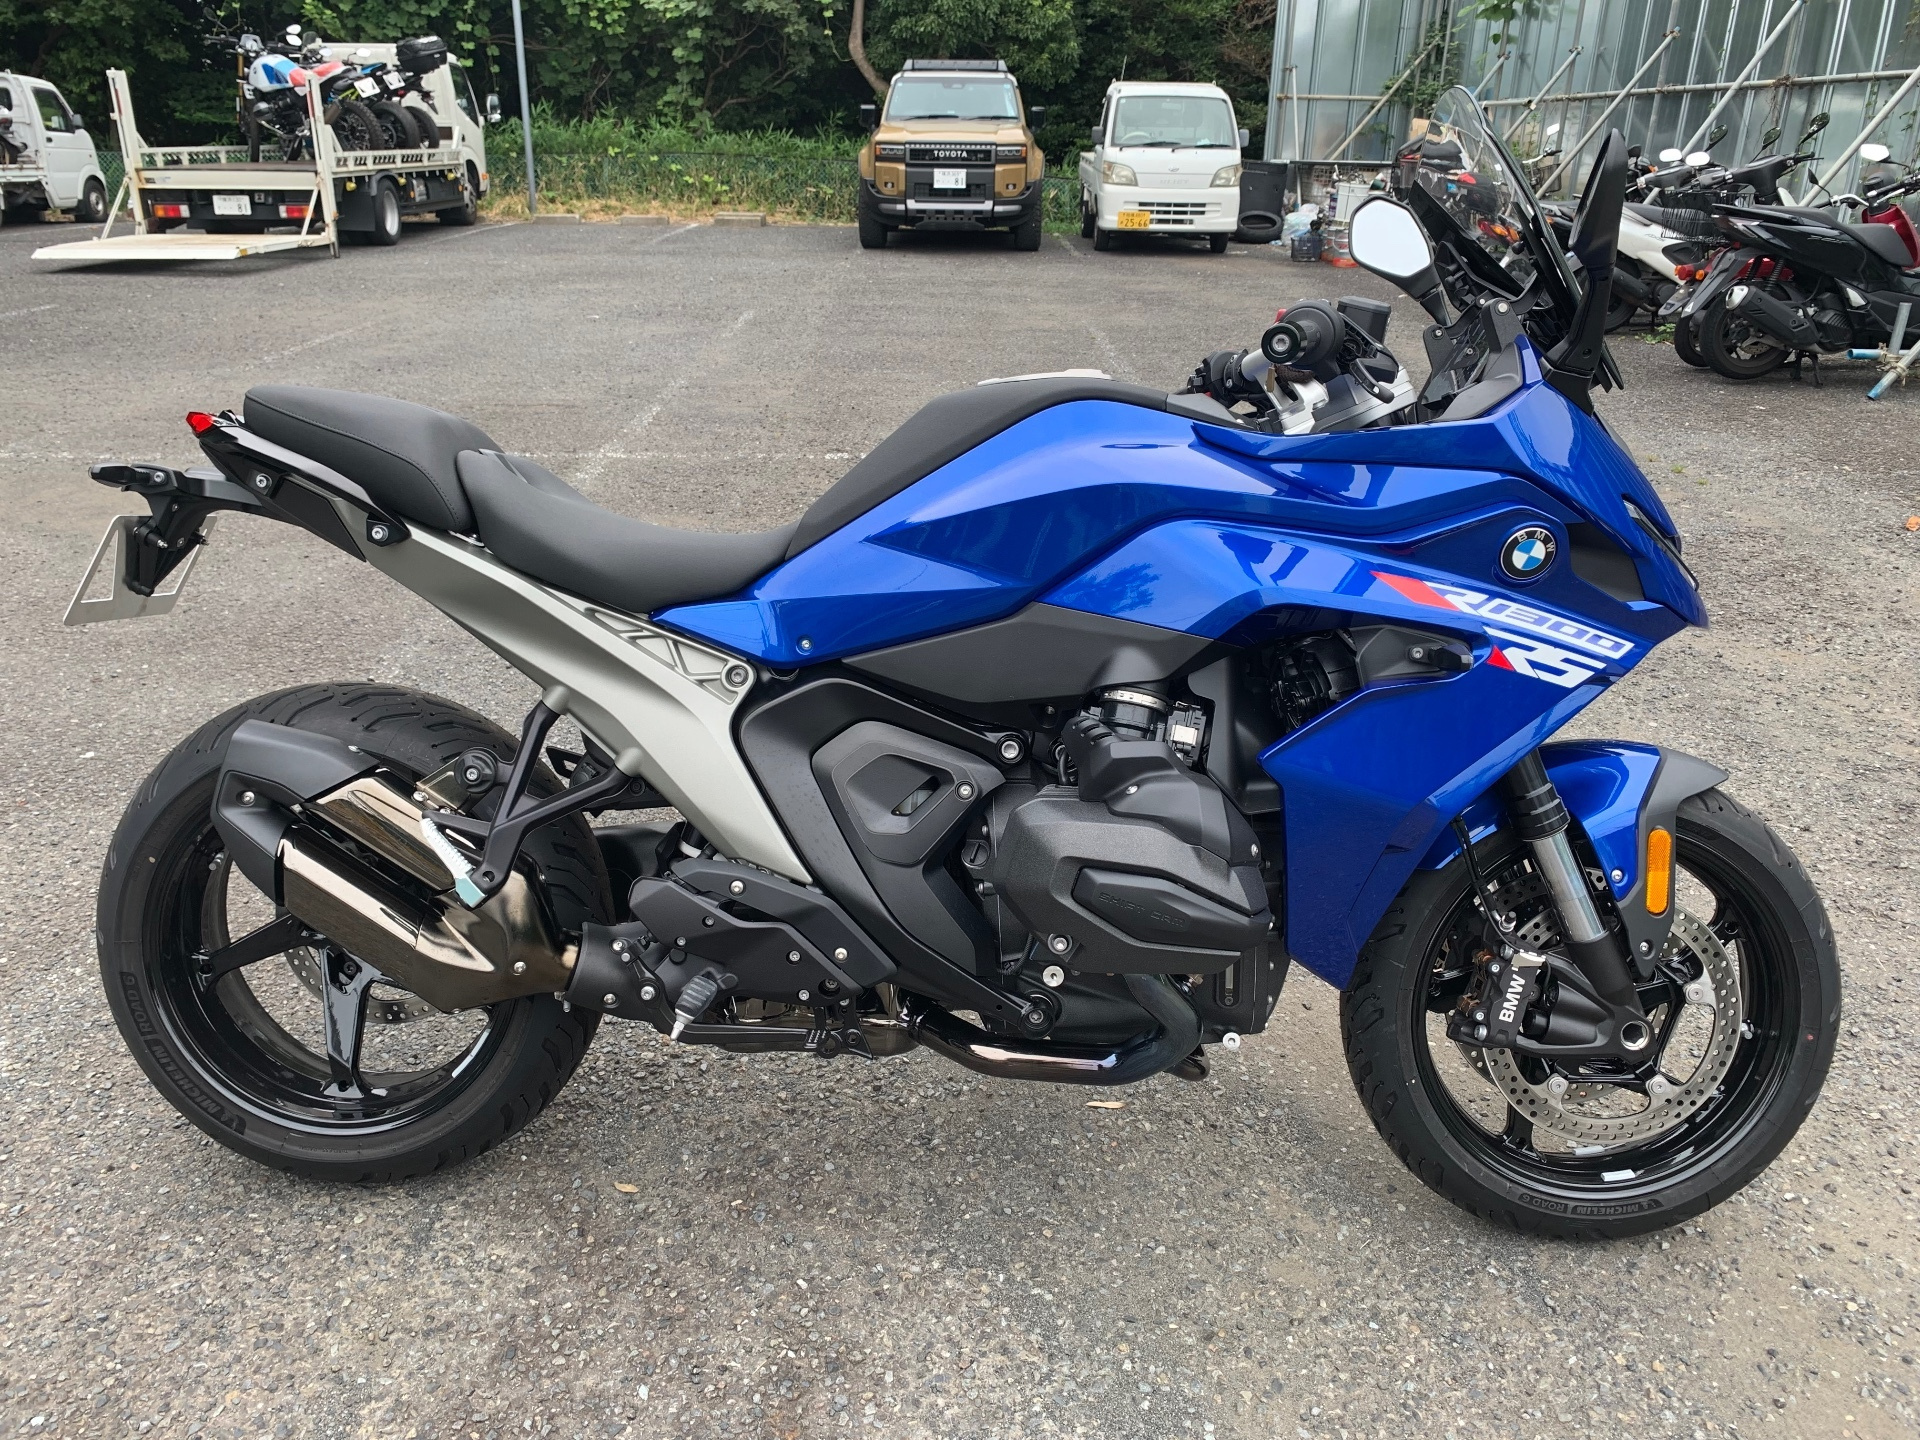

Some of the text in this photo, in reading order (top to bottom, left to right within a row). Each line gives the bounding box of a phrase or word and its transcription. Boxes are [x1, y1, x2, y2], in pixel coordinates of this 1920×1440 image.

[933, 150, 968, 158] TOYOTA
[1482, 625, 1608, 689] RS
[127, 989, 153, 1034] ROAD
[1498, 973, 1526, 1023] BMW
[153, 1045, 222, 1114] MICHELIN
[1532, 1198, 1566, 1212] ROAD
[1576, 1203, 1639, 1216] MICHELIN
